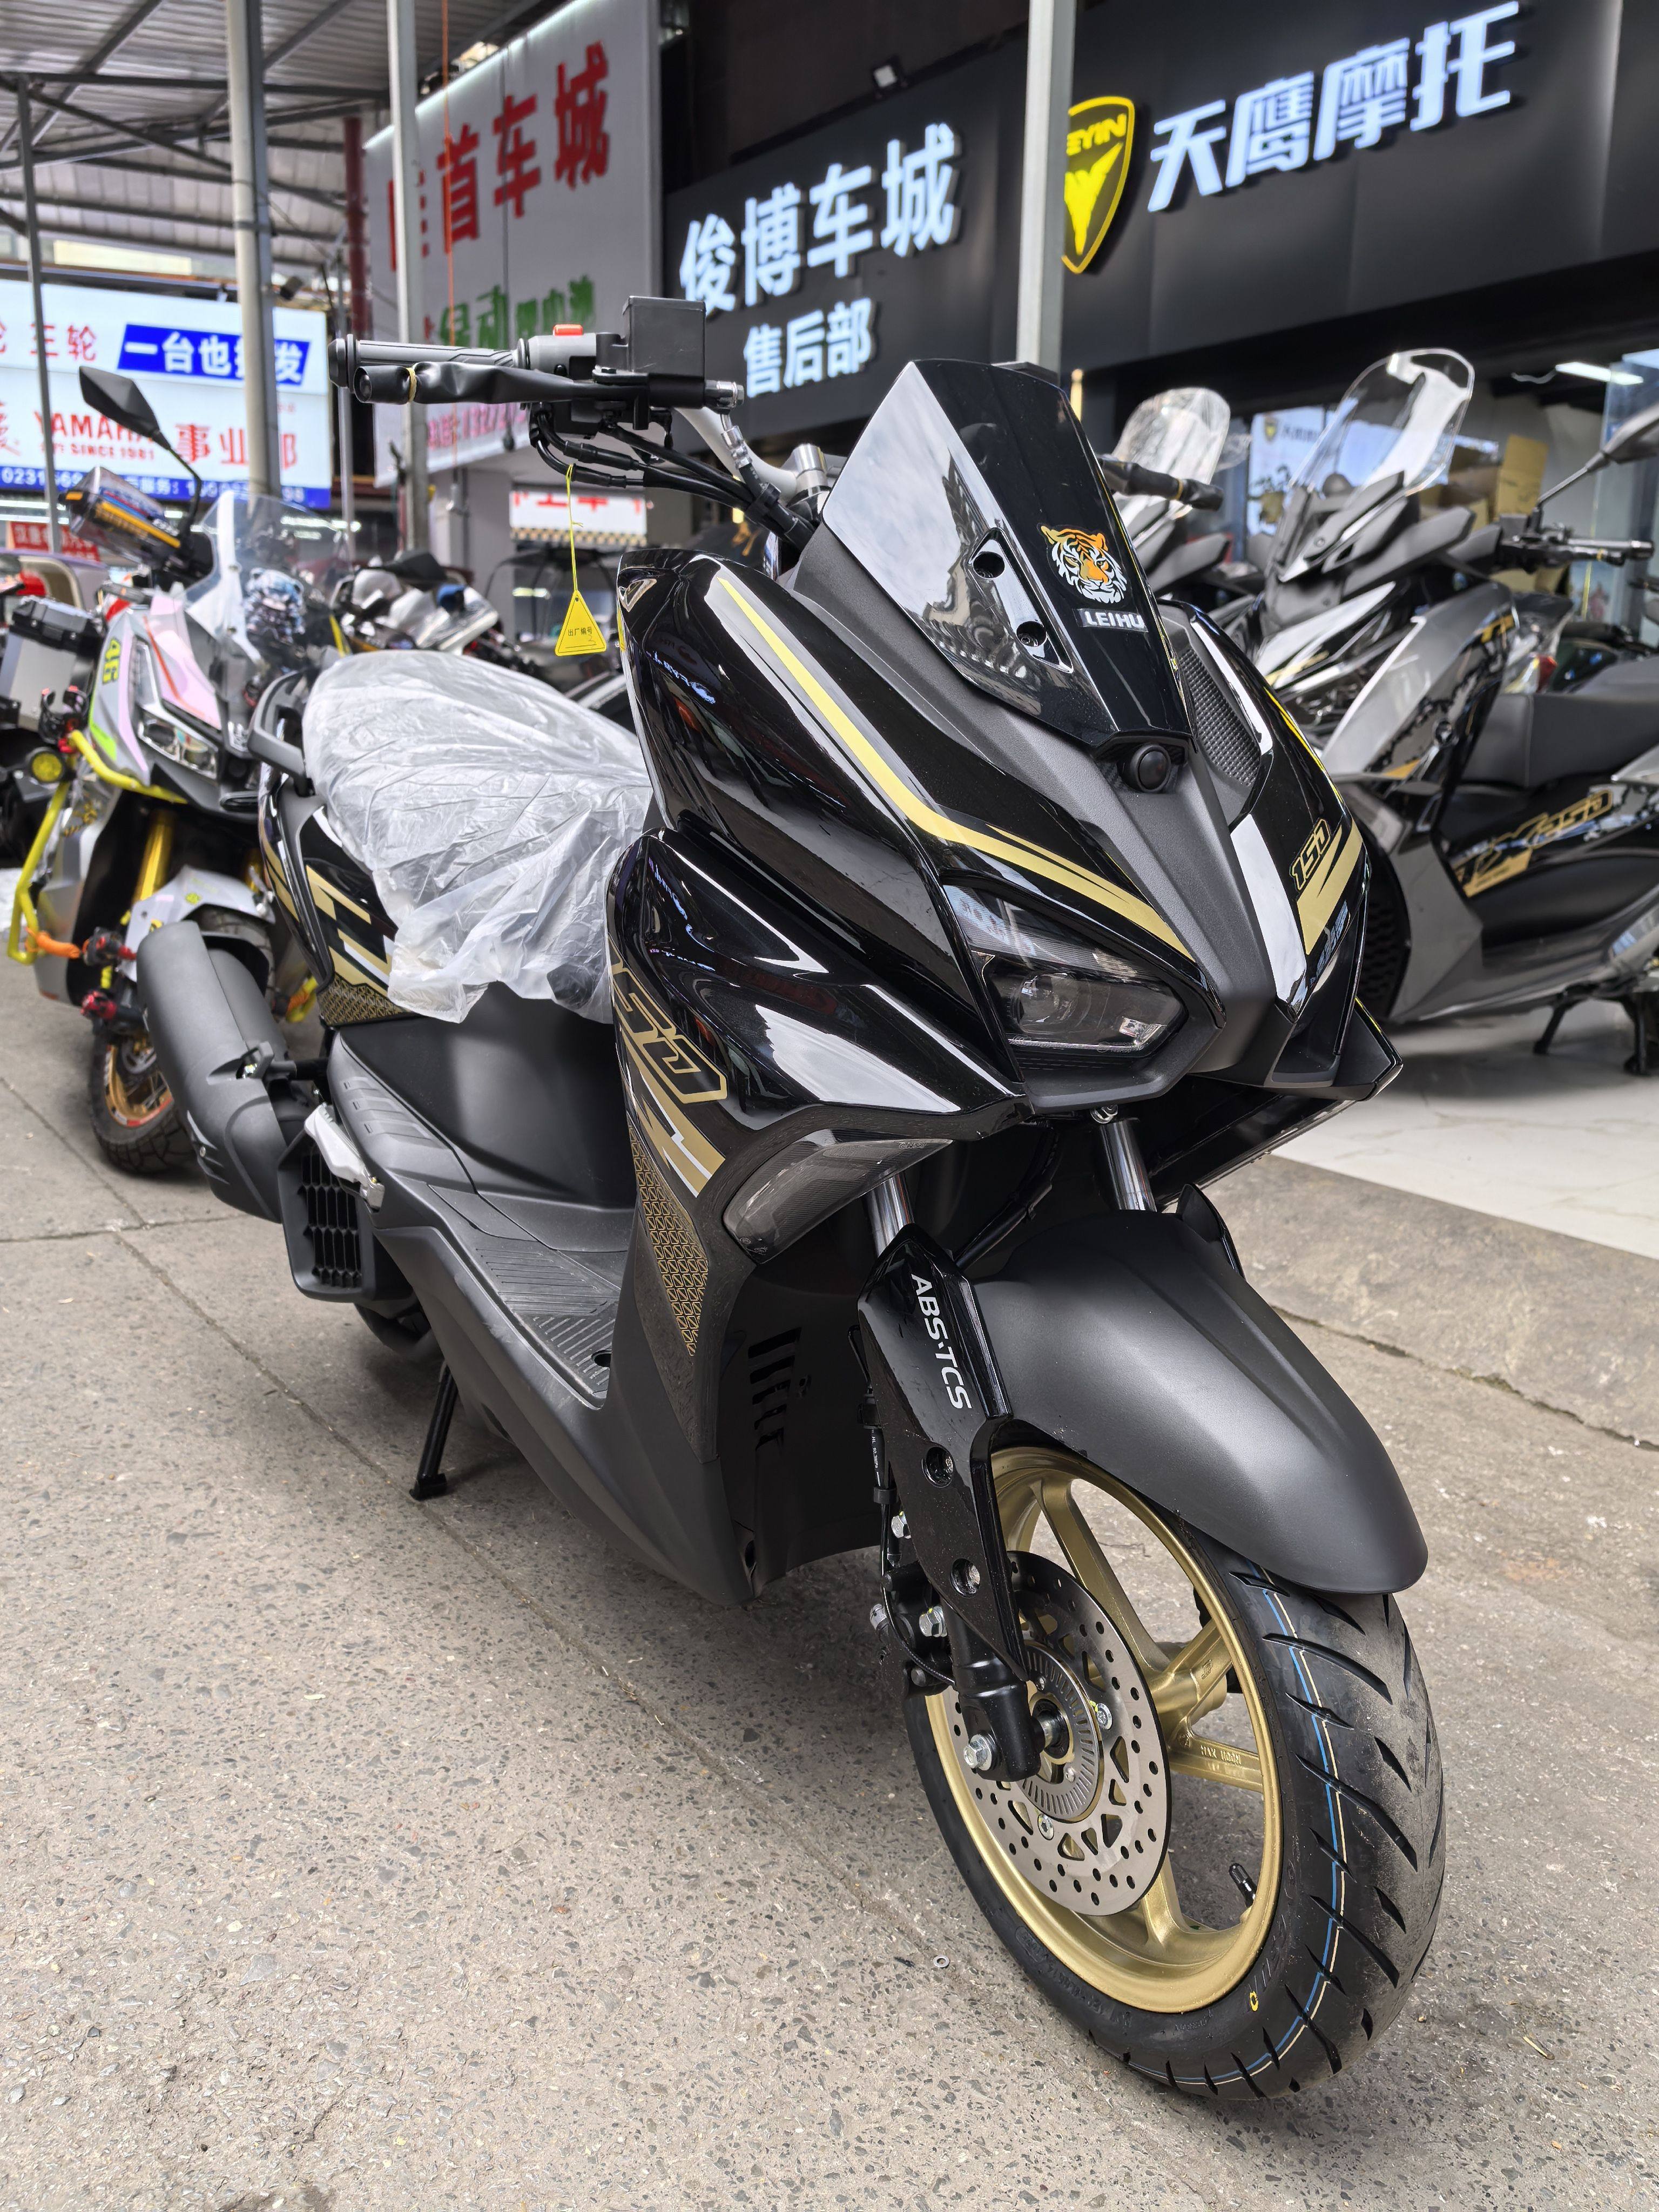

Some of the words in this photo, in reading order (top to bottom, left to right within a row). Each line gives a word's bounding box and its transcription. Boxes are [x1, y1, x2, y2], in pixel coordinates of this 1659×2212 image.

[387, 39, 610, 271] 首车城
[1066, 113, 1127, 156] EYIN
[1148, 2, 1519, 212] 天鹰摩托
[679, 123, 957, 316] 俊博车城
[743, 297, 874, 399] 售后部
[1084, 611, 1145, 629] LEIHU
[1292, 819, 1331, 891] 150
